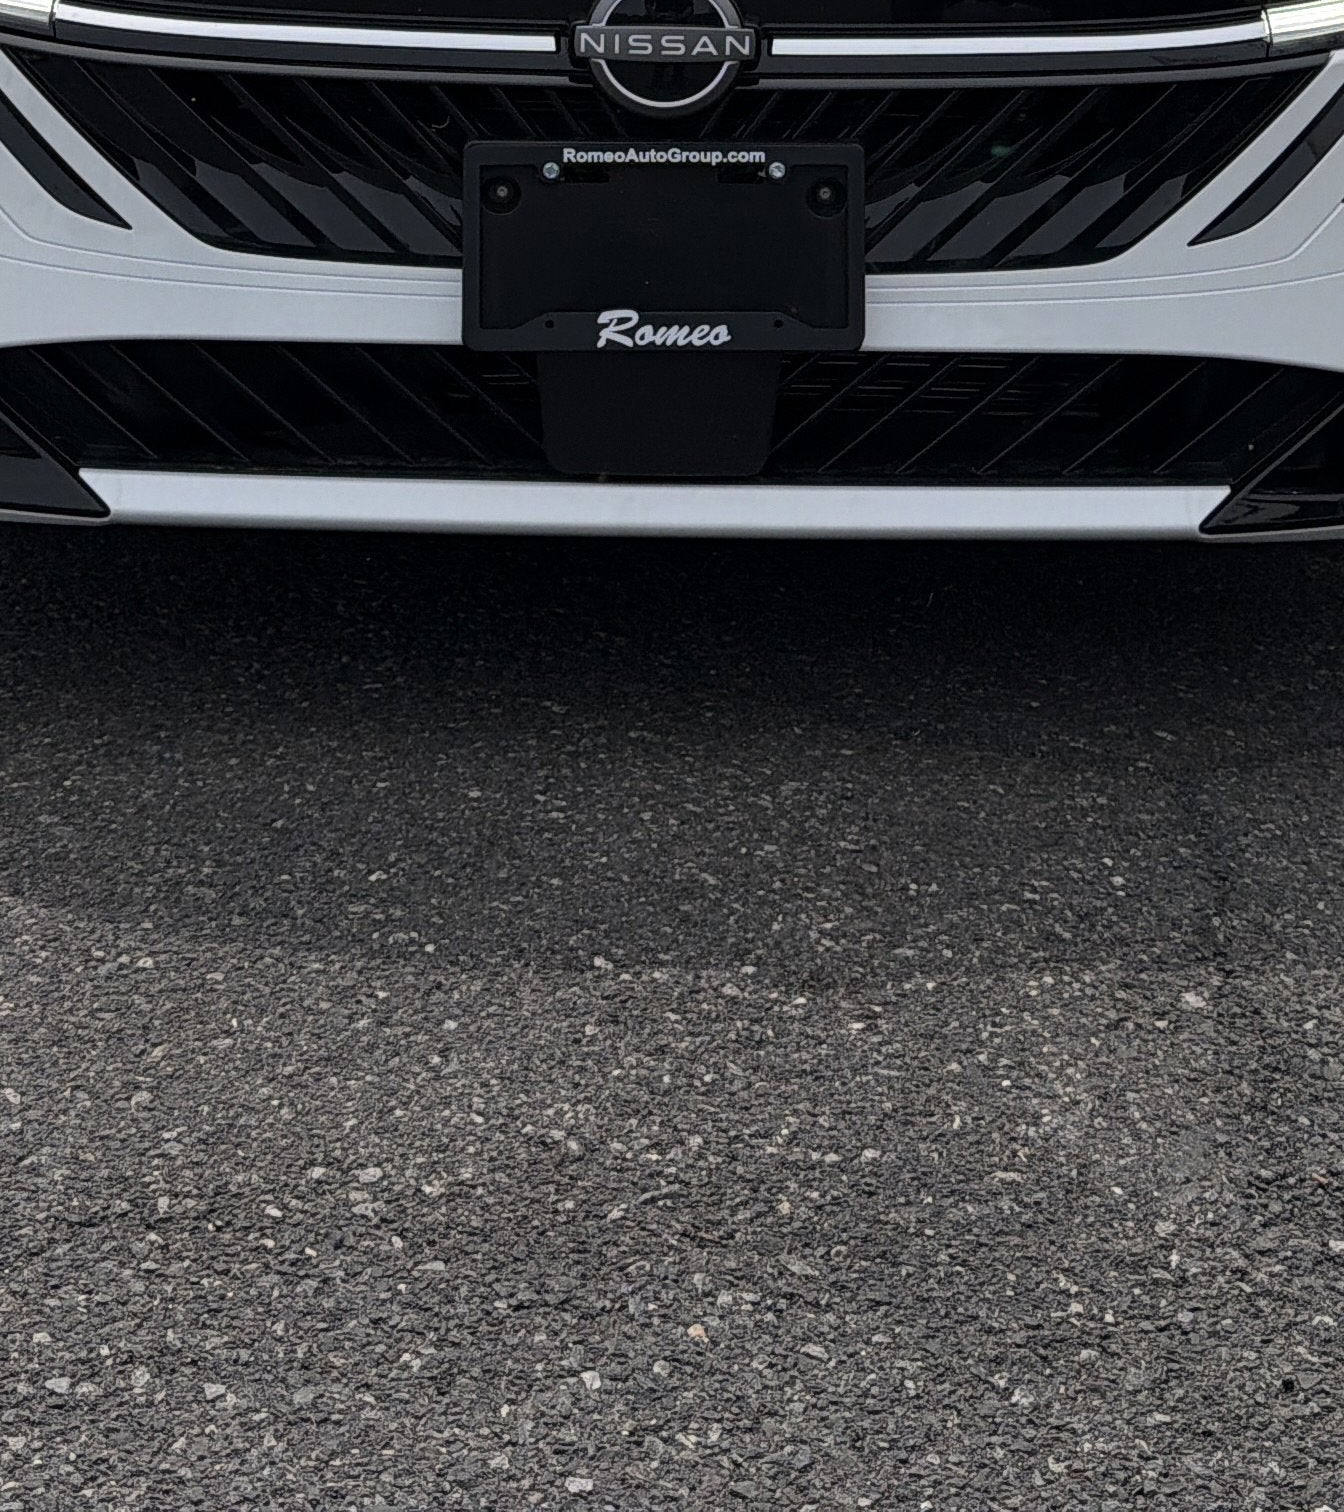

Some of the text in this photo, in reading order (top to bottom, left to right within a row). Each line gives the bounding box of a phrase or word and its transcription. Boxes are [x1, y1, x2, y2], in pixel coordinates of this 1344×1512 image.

[579, 32, 751, 56] NISSAN
[562, 147, 766, 166] RomeoAutoGroup.com
[596, 309, 732, 348] Romeo
